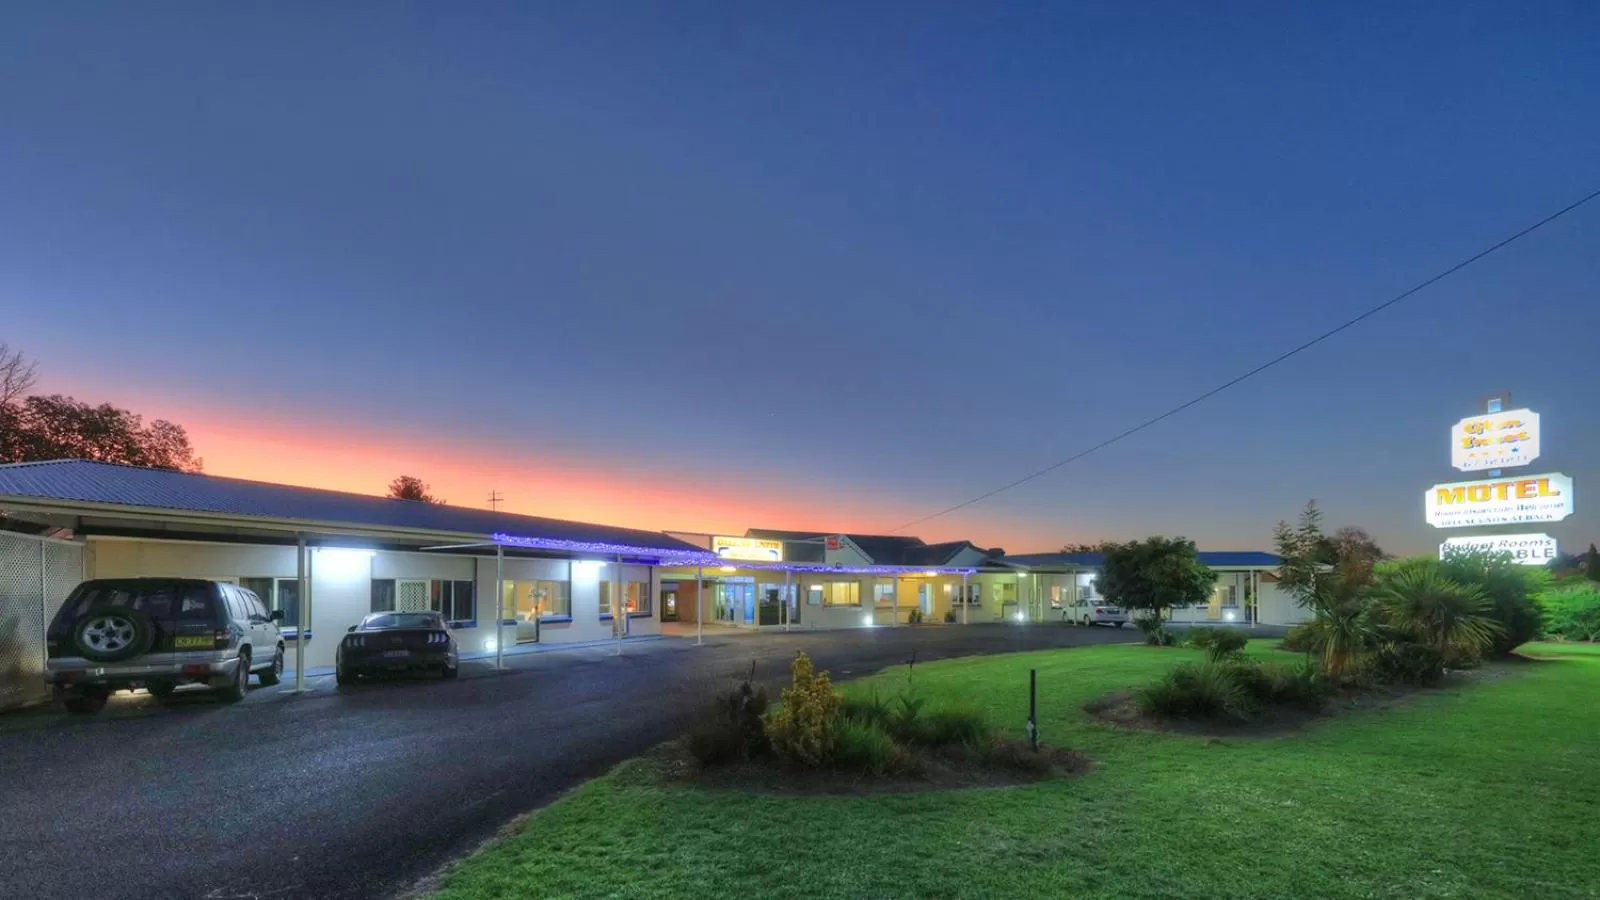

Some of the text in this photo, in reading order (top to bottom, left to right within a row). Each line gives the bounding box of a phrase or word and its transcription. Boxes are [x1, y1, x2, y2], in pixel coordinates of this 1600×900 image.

[1436, 478, 1561, 505] MOTEL
[1442, 539, 1552, 554] Budget Rooms
